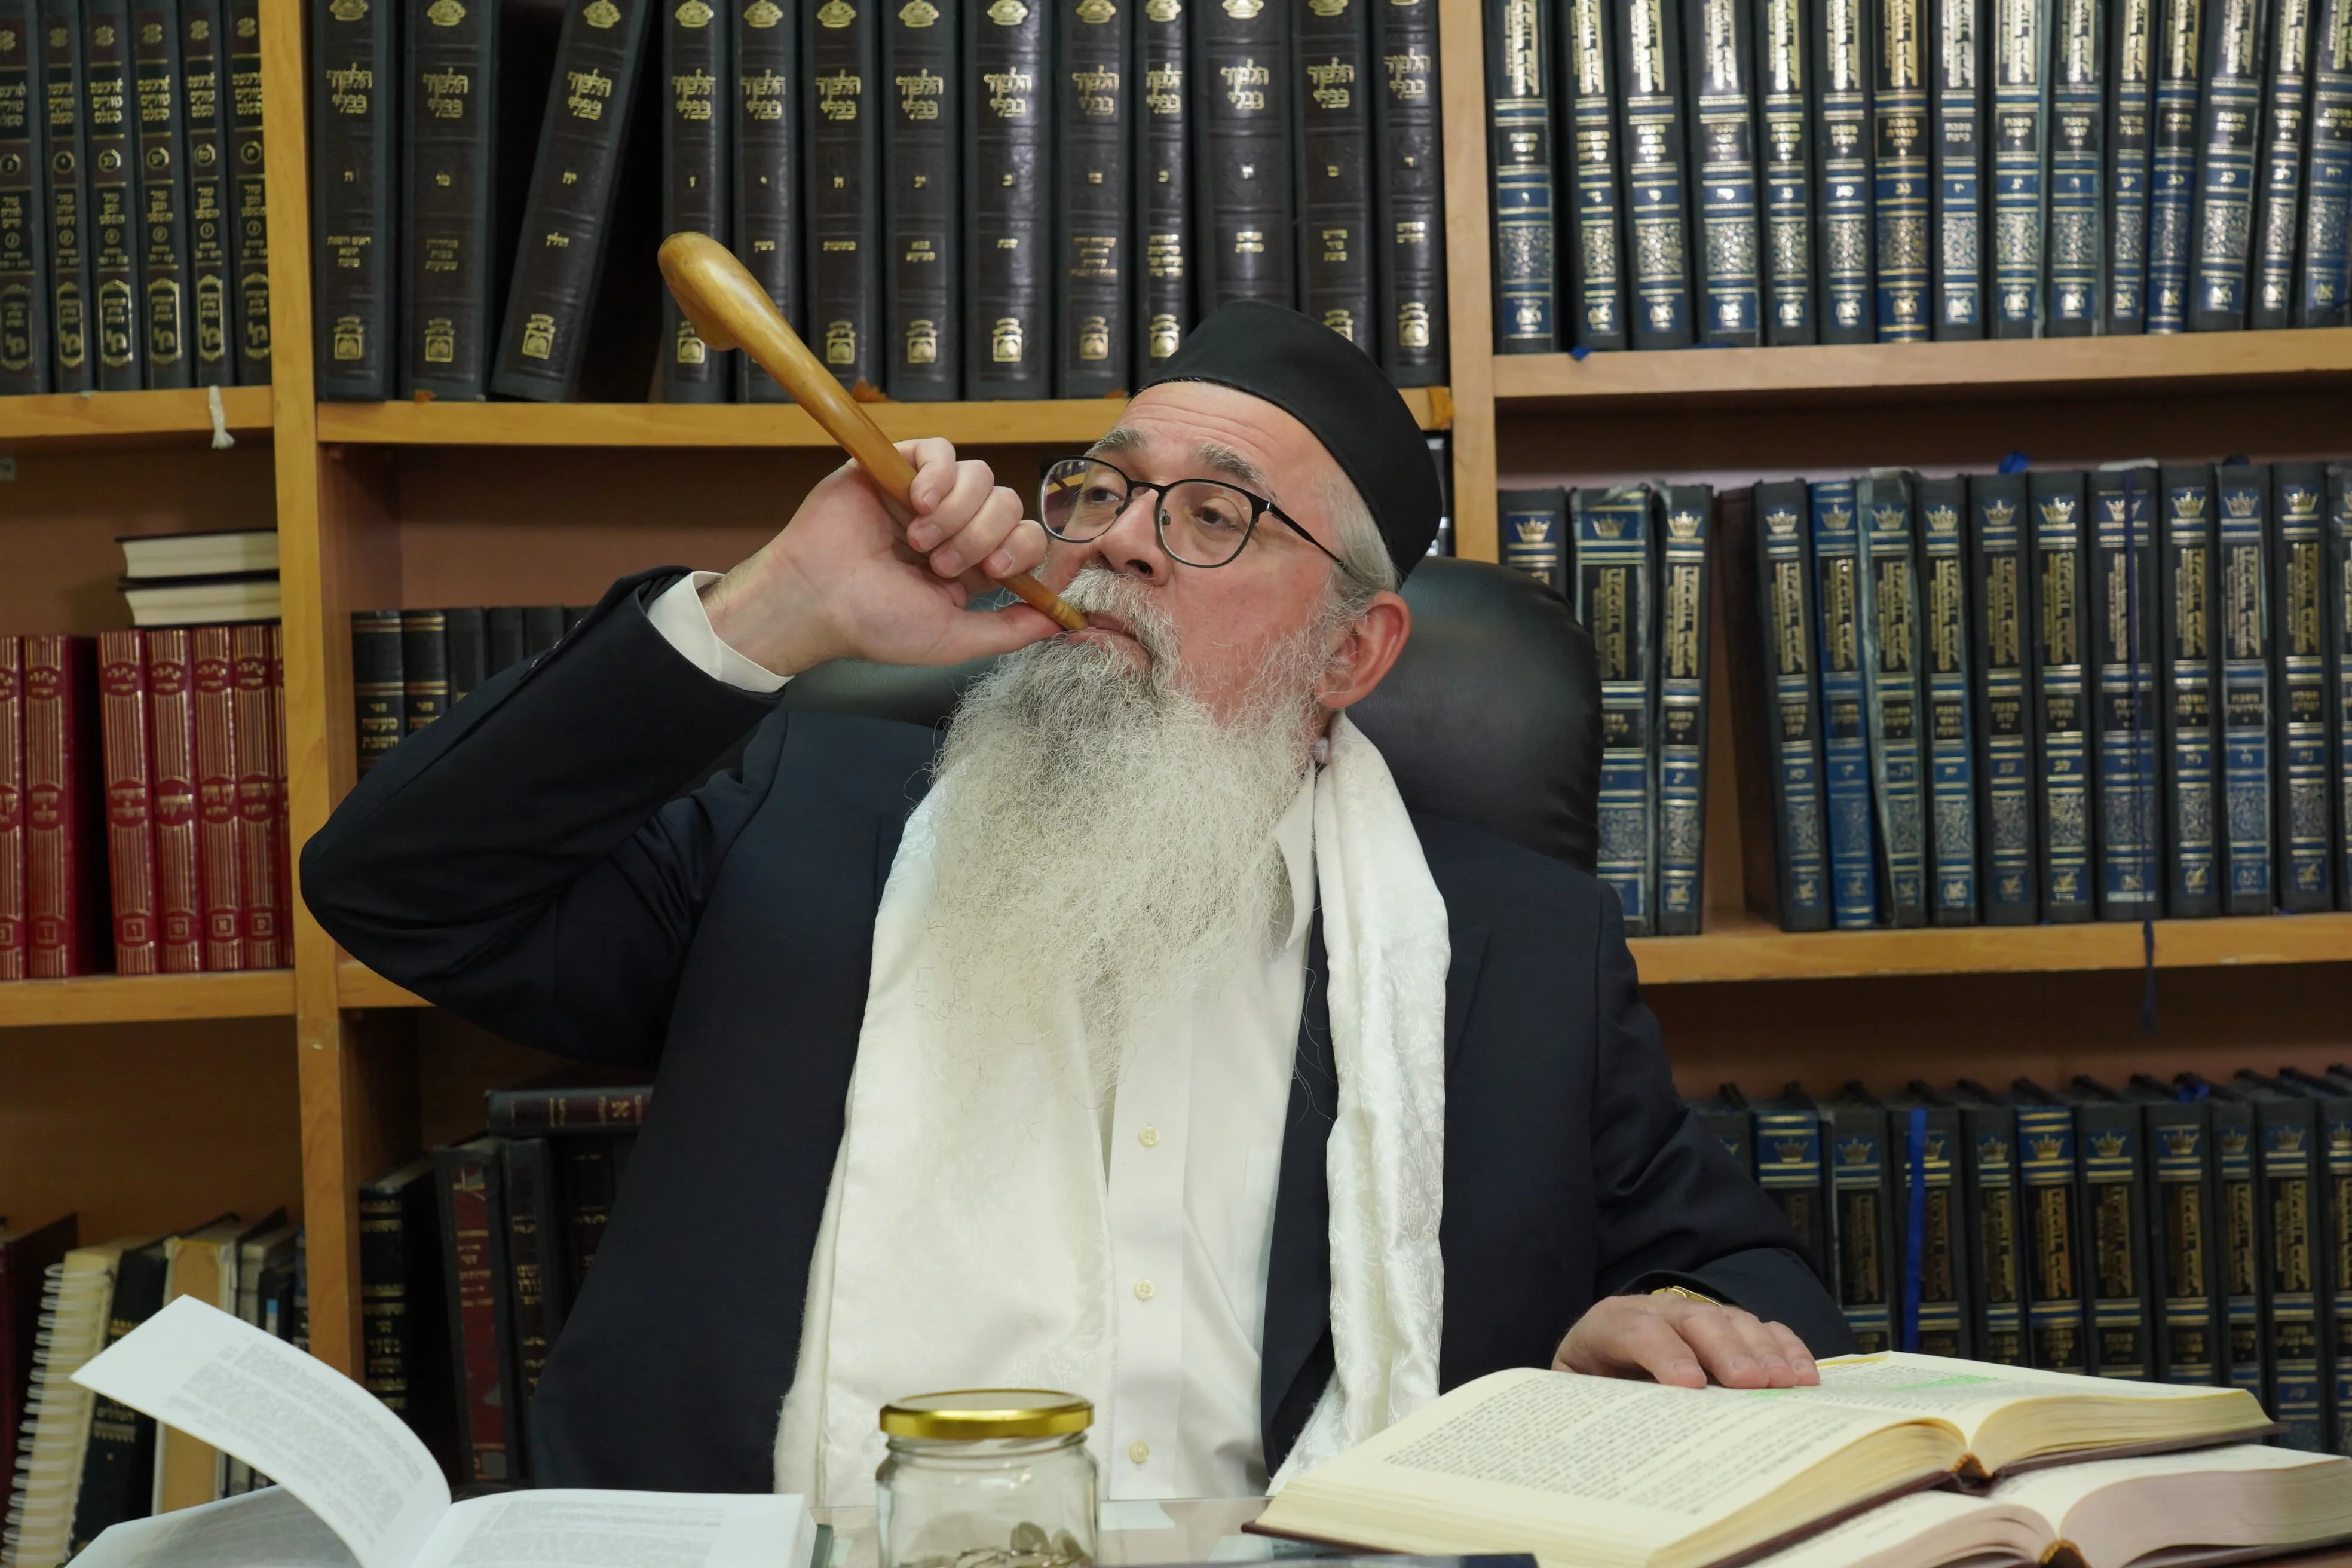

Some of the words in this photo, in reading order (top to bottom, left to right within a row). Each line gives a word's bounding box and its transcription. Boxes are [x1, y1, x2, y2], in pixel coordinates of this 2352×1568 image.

[1220, 59, 1269, 91] תלמוד
[1306, 57, 1355, 90] תלמוד
[1384, 48, 1431, 79] תלמוד
[326, 62, 373, 94] תלמוד
[422, 67, 469, 96] תלמוד
[566, 68, 612, 99] תלמוד
[671, 68, 716, 99] תלמוד
[740, 68, 786, 99] תלמוד
[815, 68, 862, 99] תלמוד
[895, 68, 944, 100] תלמוד
[984, 66, 1033, 99] תלמוד
[1072, 64, 1120, 96] תלמוד
[1146, 63, 1182, 96] תלמוד
[1390, 79, 1426, 99] בבלי
[332, 94, 368, 114] בבלי
[427, 98, 463, 118] בבלי
[568, 95, 602, 120] בבלי
[676, 99, 712, 120] בבלי
[745, 99, 783, 120] בבלי
[820, 99, 857, 120] בבלי
[901, 99, 939, 120] בבלי
[990, 97, 1027, 117] בבלי
[1080, 95, 1114, 116] בבלי
[1146, 95, 1180, 114] בבלי
[1227, 90, 1264, 111] בבלי
[1313, 89, 1350, 109] בבלי
